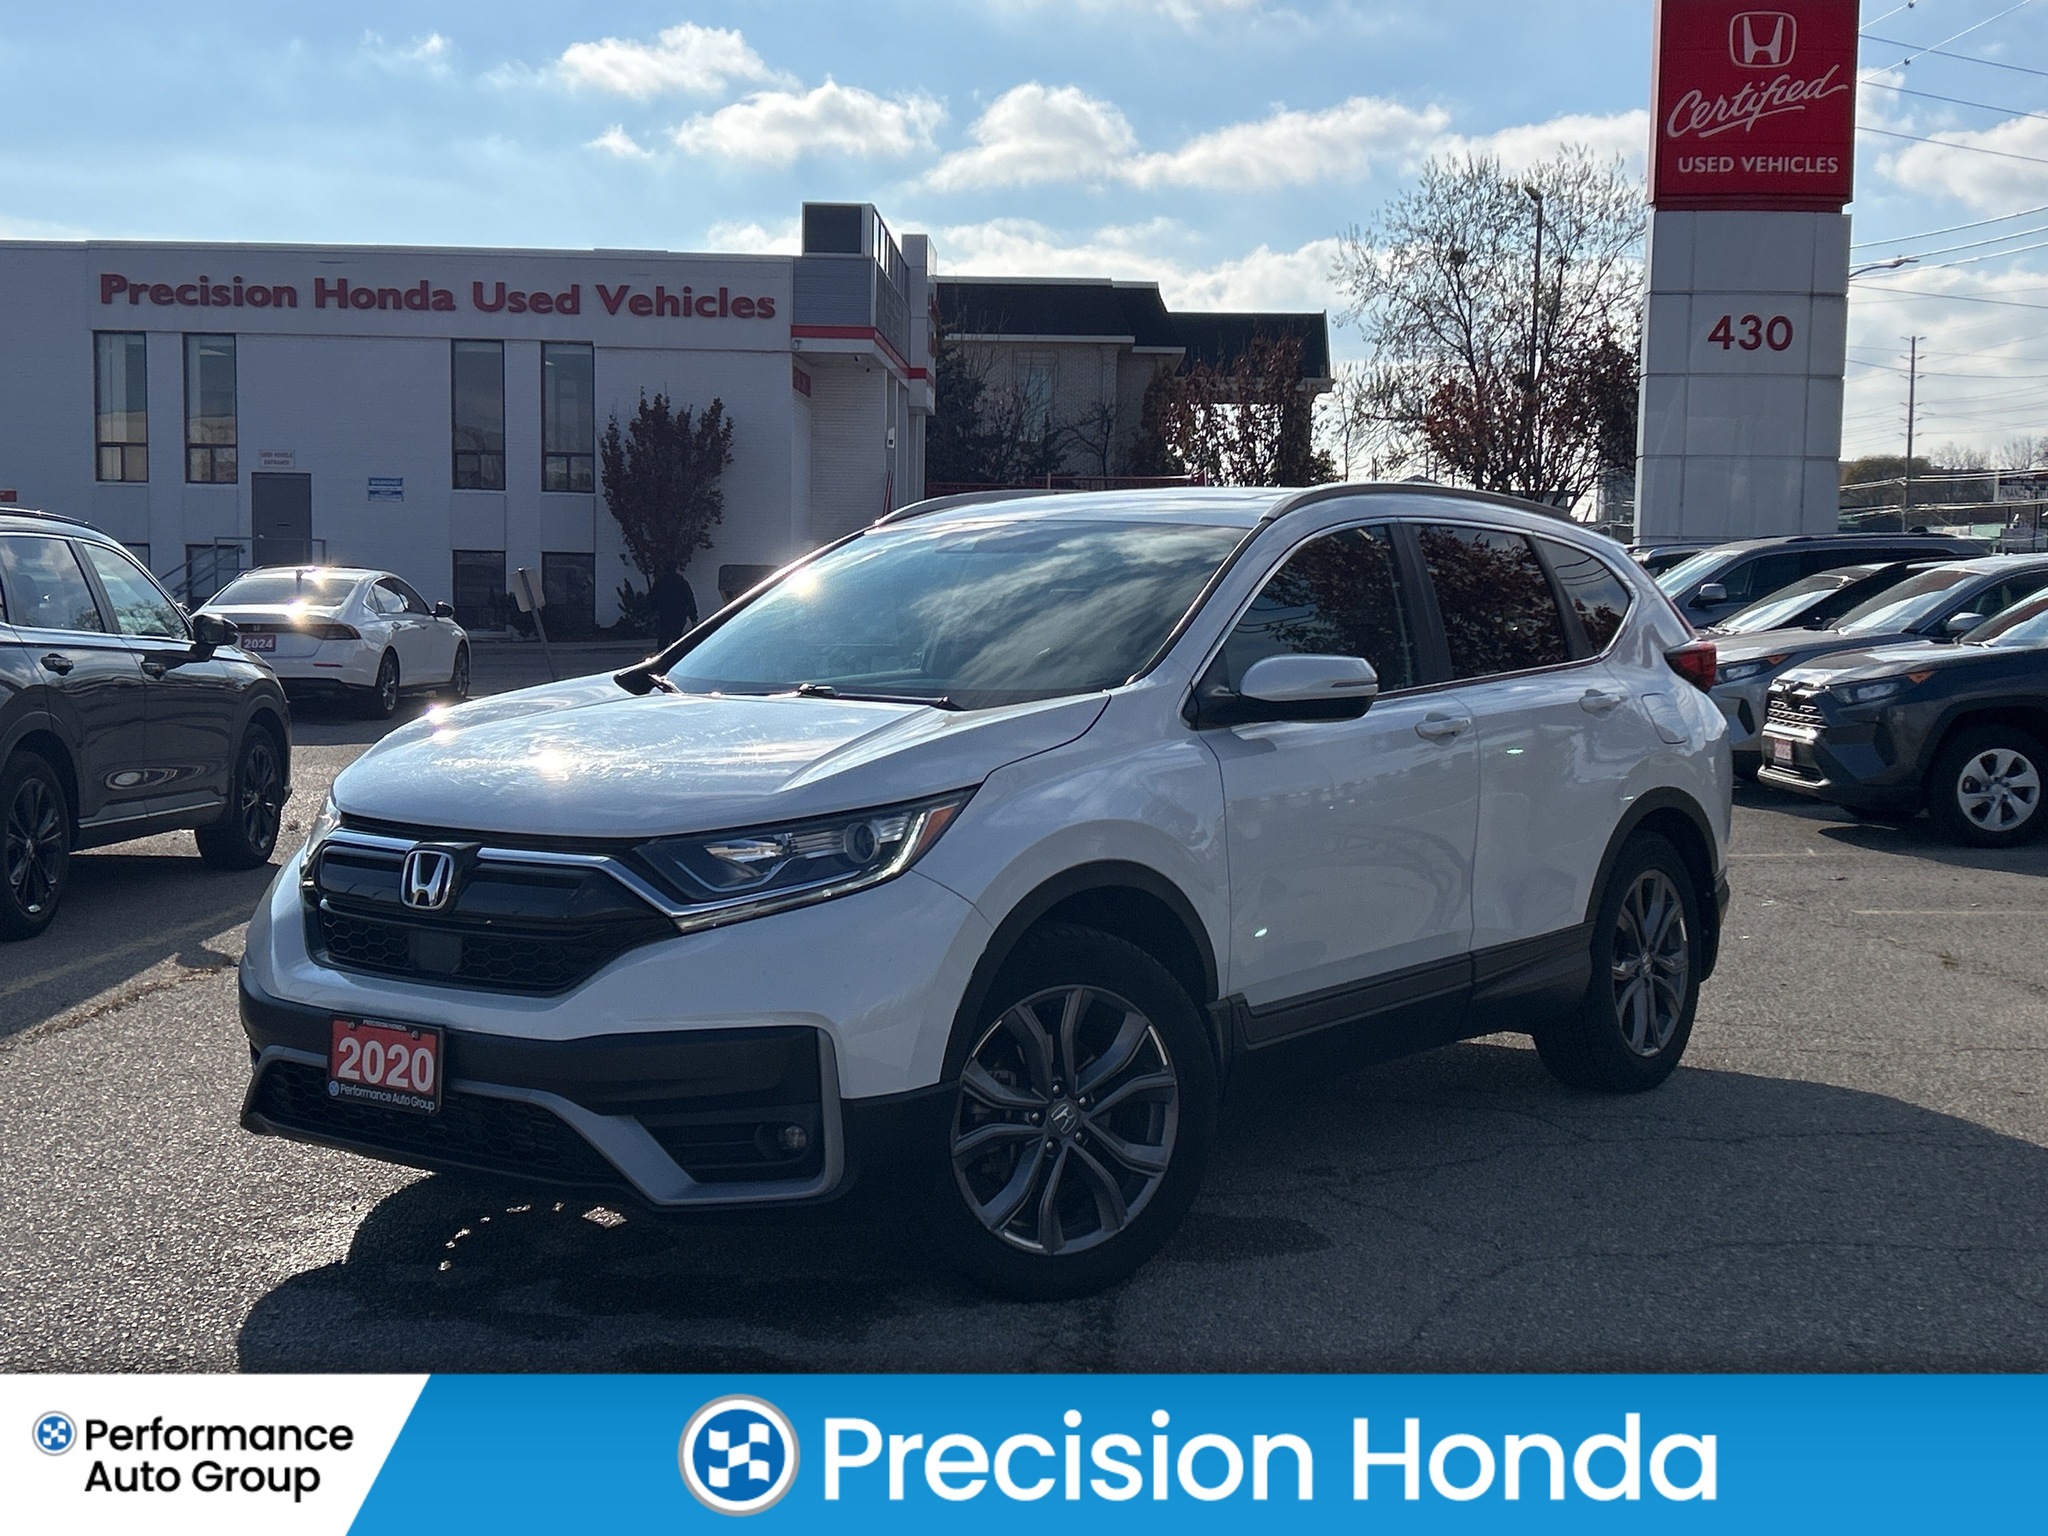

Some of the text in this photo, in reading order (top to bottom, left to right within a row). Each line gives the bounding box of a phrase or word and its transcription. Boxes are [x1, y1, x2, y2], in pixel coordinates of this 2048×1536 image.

[1667, 63, 1849, 138] Certified
[1678, 156, 1839, 174] USED VEHICLES
[100, 273, 776, 319] Precision Honda Used Vehicles
[1707, 314, 1794, 351] 430
[244, 638, 274, 649] 2024
[337, 1036, 435, 1092] 2020
[340, 1083, 436, 1113] Performance Auto Group
